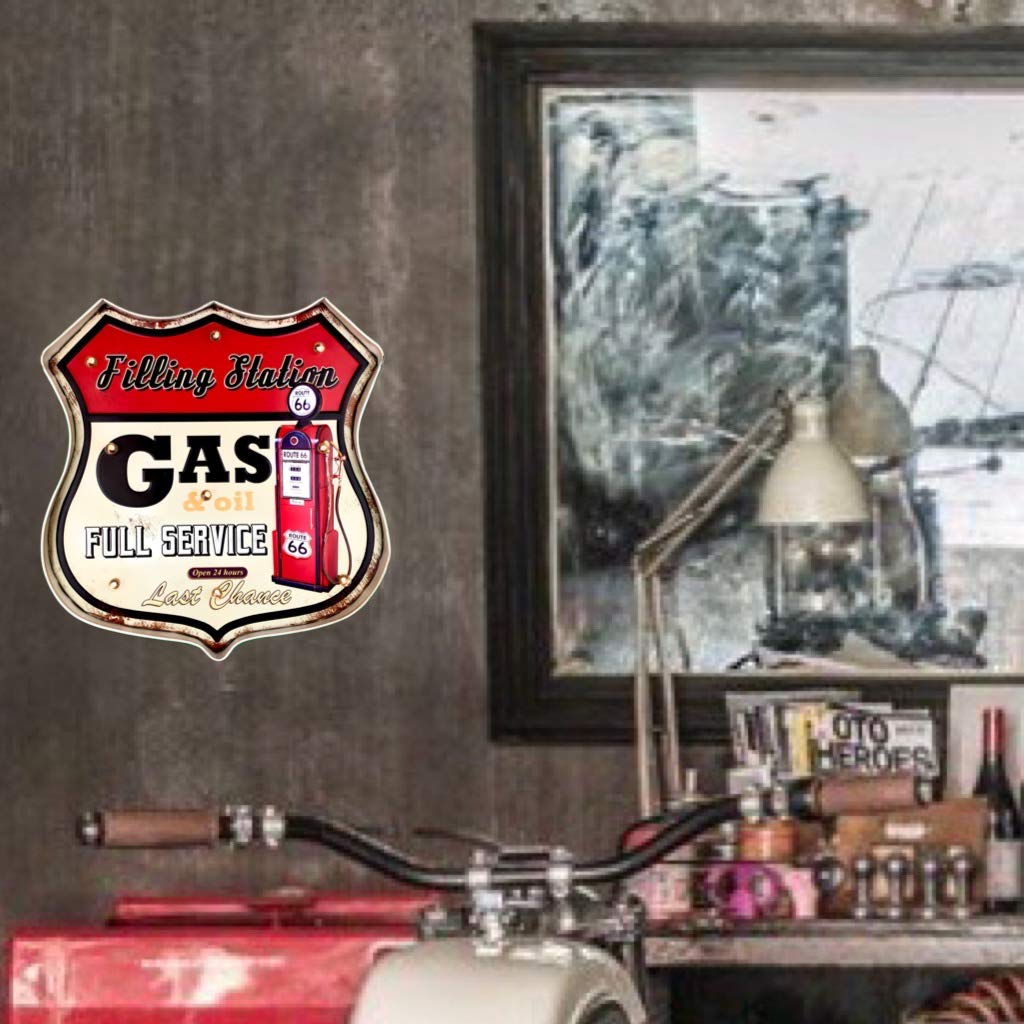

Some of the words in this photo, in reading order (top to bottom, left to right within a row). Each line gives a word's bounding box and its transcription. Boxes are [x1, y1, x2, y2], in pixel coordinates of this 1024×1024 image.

[96, 354, 216, 398] Filling
[224, 353, 339, 391] Station
[294, 398, 311, 411] 66
[283, 451, 299, 459] ROUTE
[96, 433, 272, 508] GAS
[183, 491, 205, 512] &
[214, 491, 255, 512] oil
[85, 526, 152, 559] FULL
[161, 523, 268, 556] SERVICE
[288, 533, 307, 541] ROUTE
[287, 540, 308, 555] 66
[192, 569, 211, 578] Open
[223, 568, 244, 576] hours
[141, 580, 203, 607] Last
[209, 579, 293, 610] Chance
